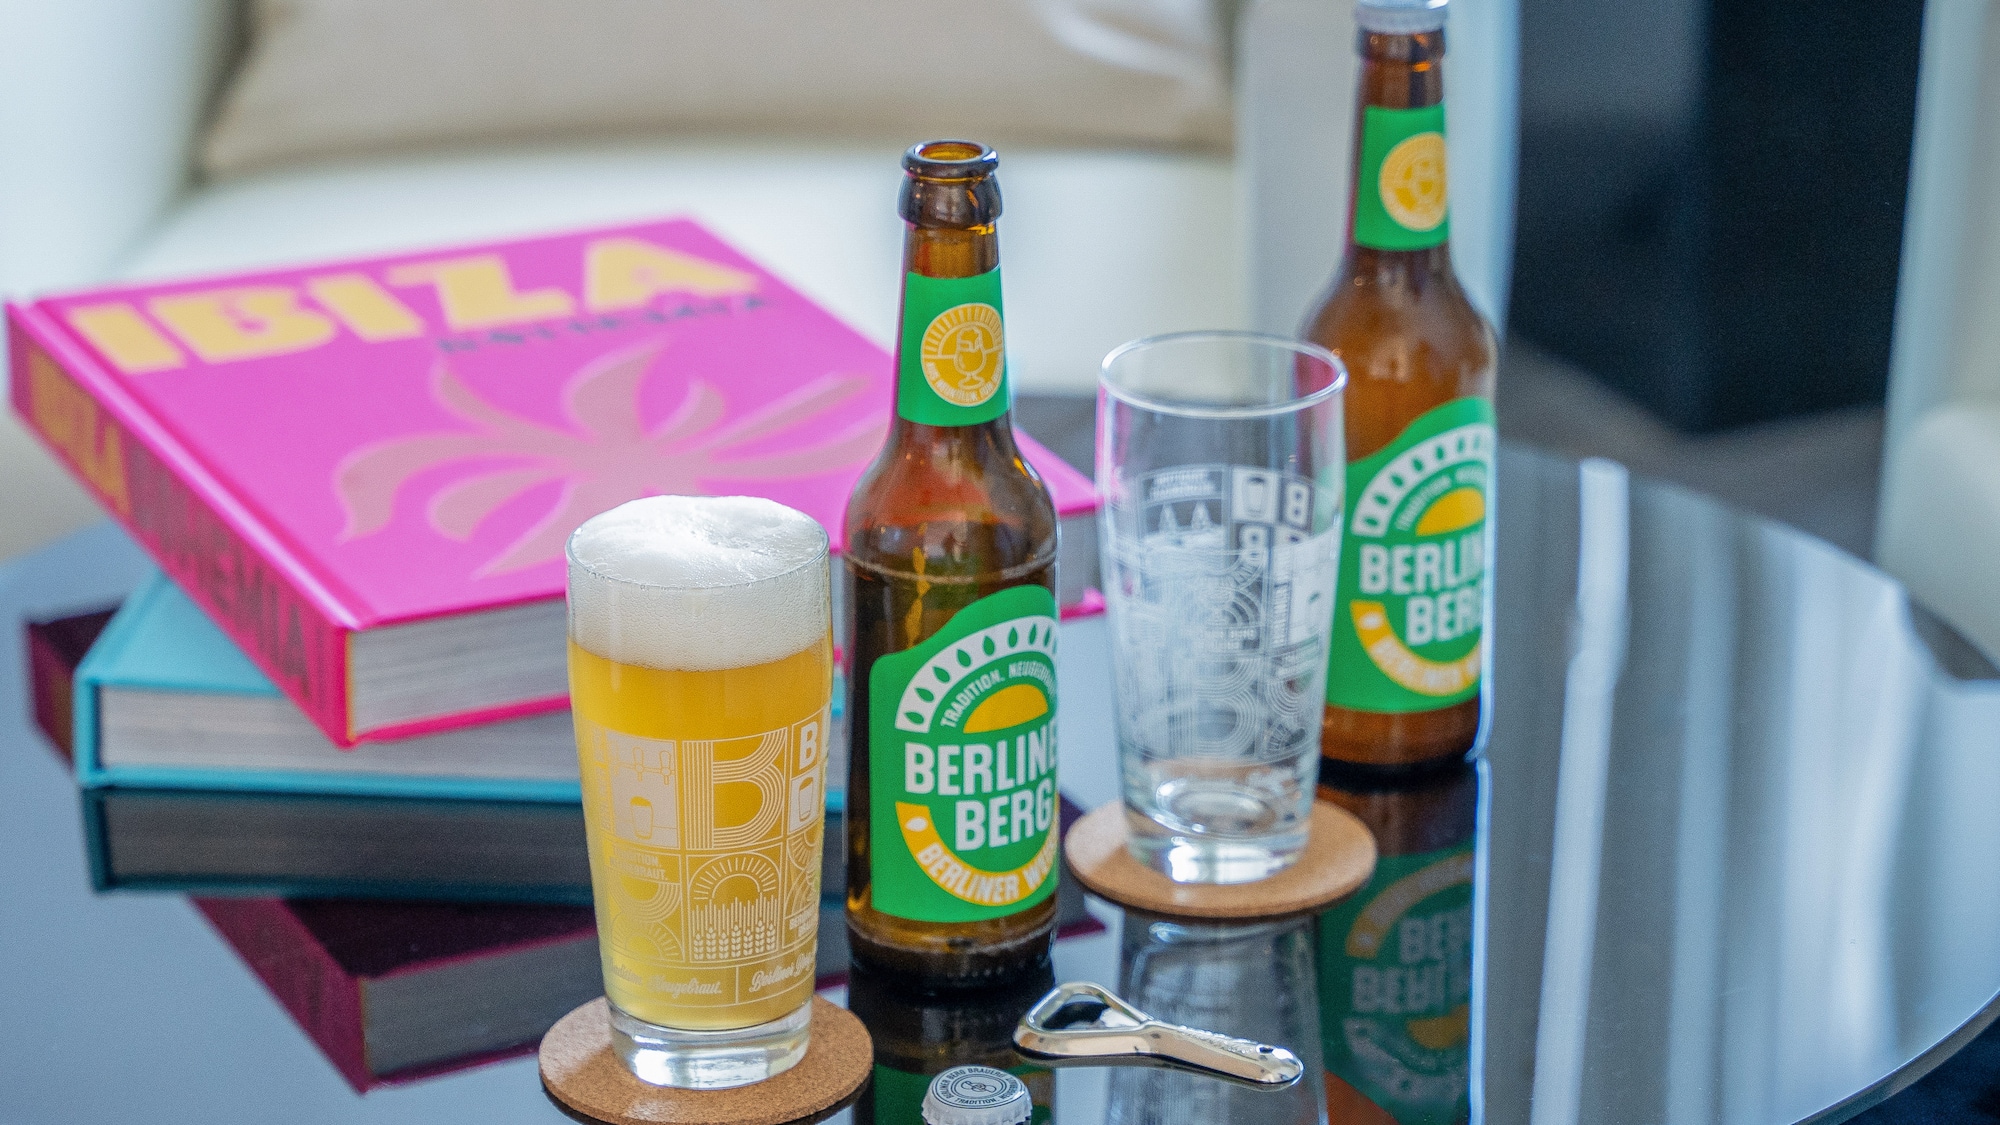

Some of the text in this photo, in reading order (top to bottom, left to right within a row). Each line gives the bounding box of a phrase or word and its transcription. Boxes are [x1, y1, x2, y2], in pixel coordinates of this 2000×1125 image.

[68, 237, 759, 374] IBIZA
[955, 777, 1053, 851] BERG
[917, 842, 1020, 902] BERLINER
